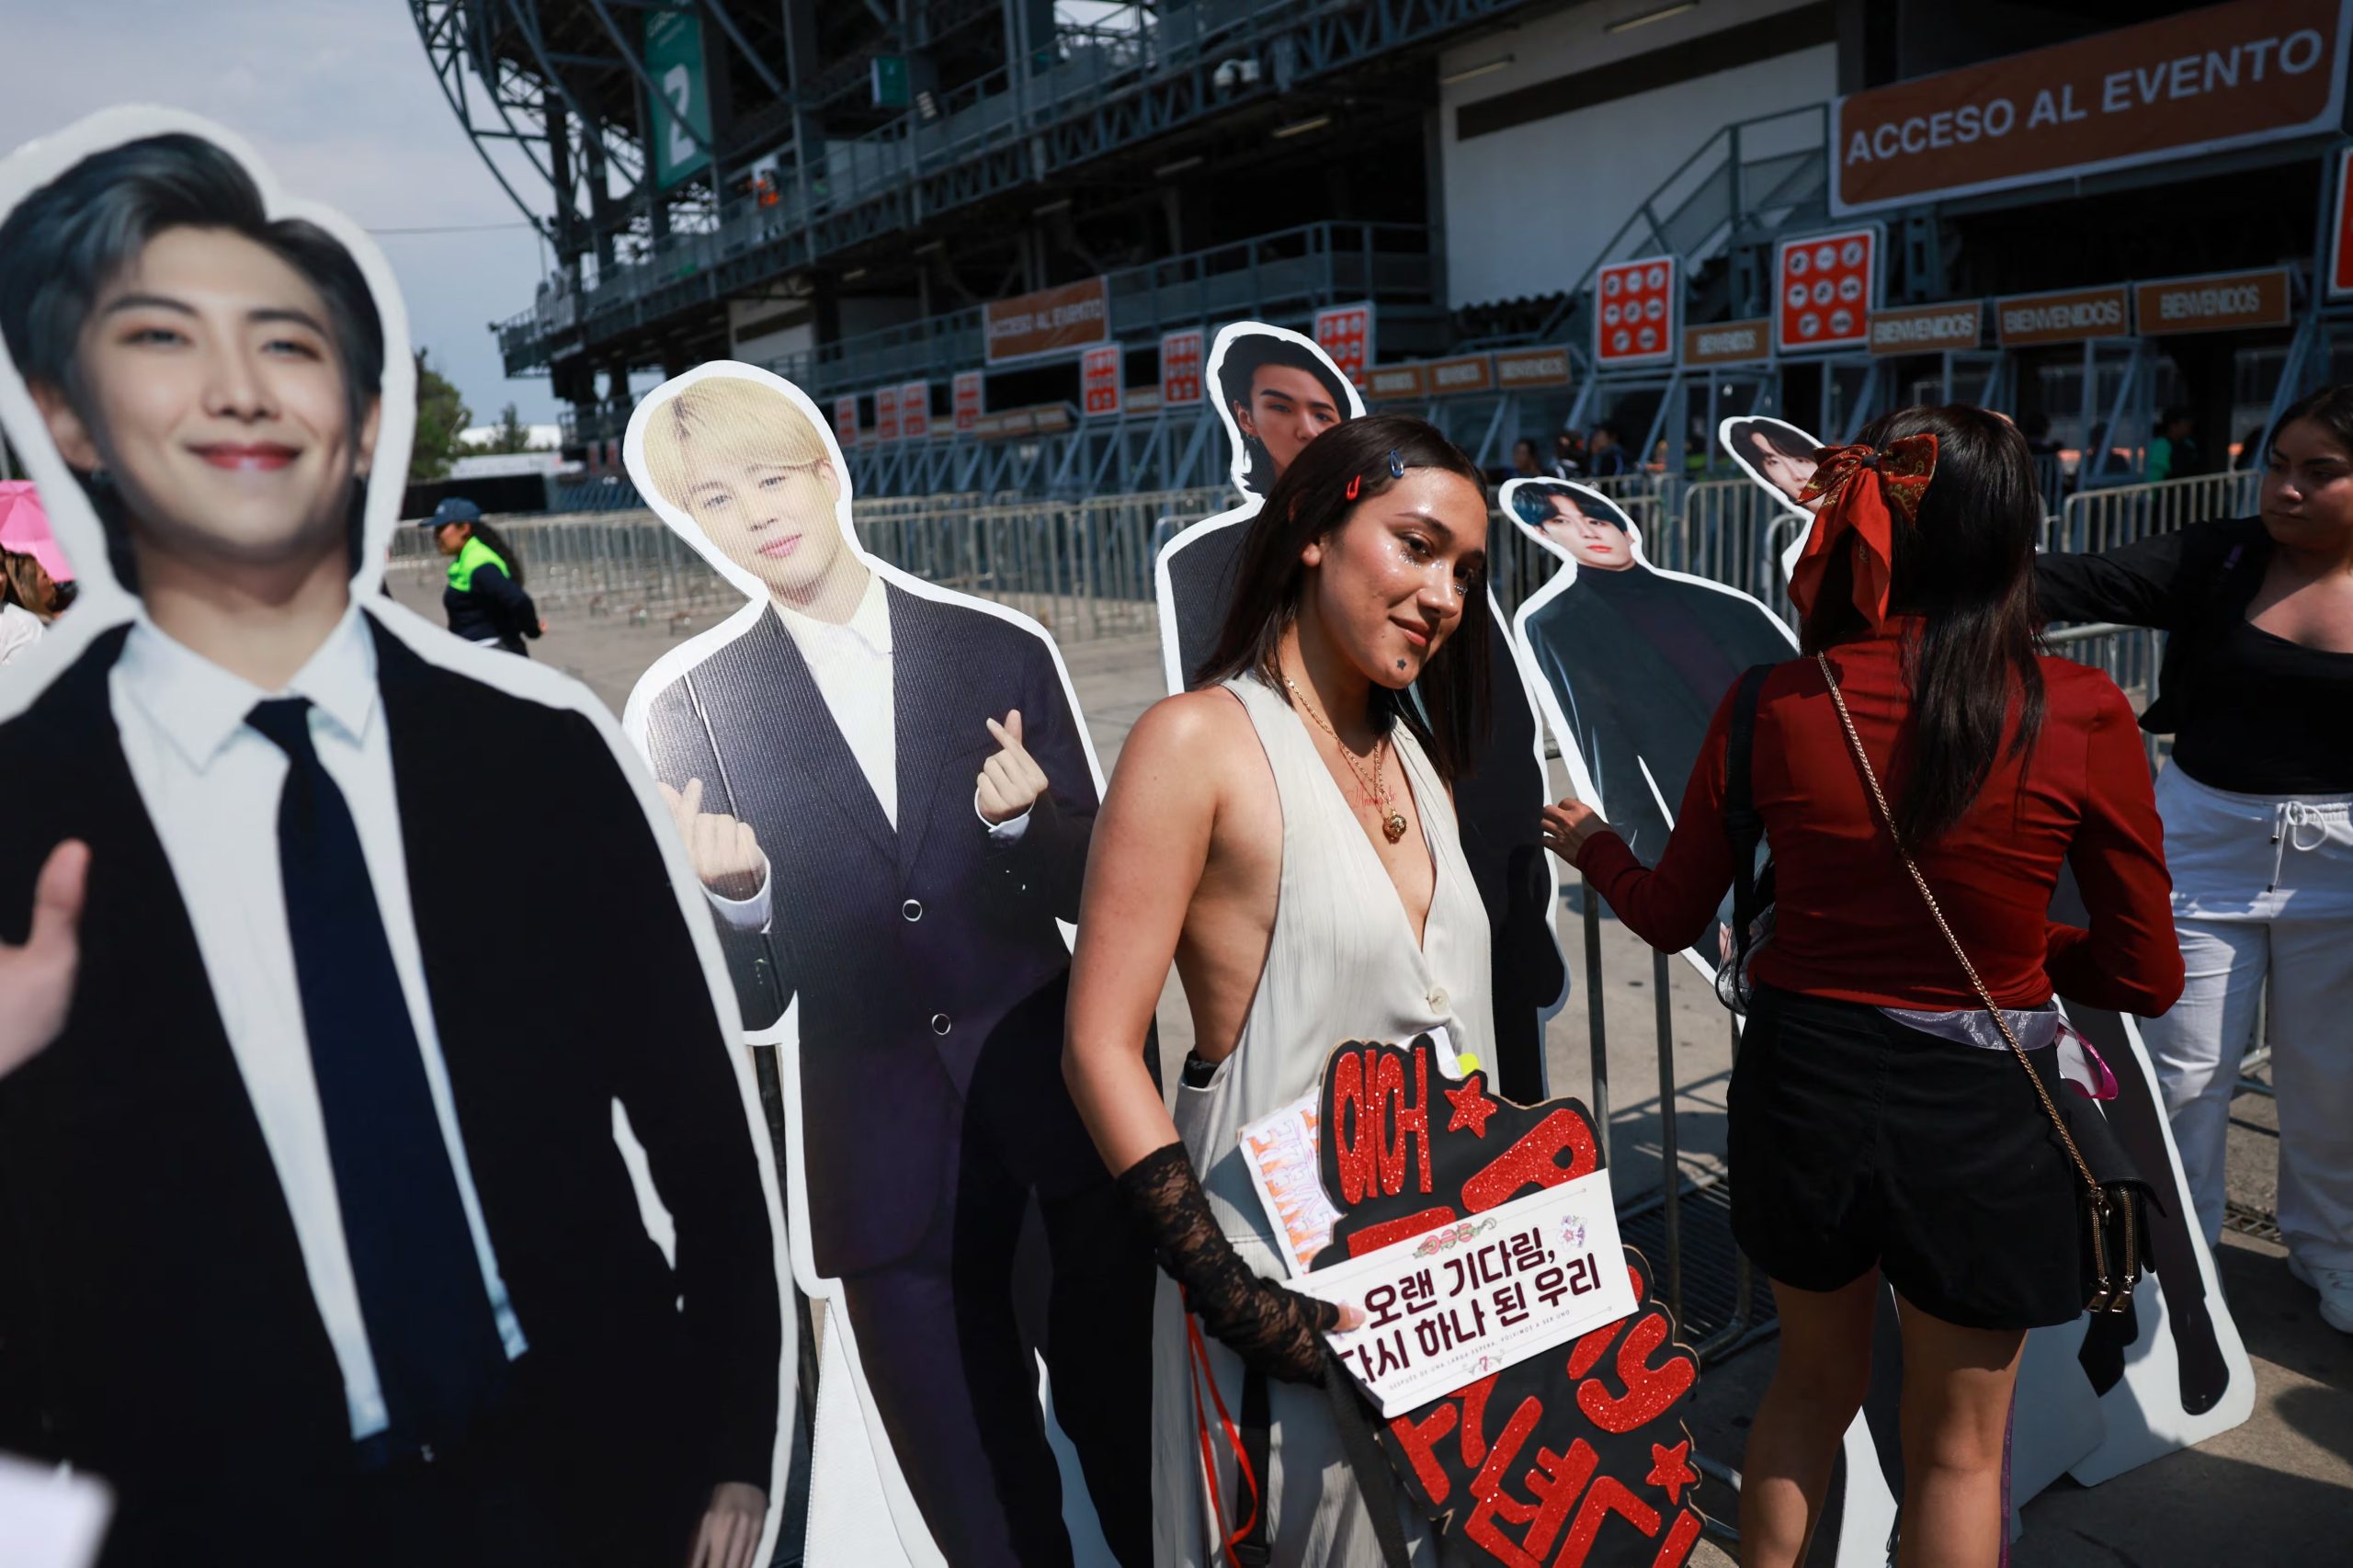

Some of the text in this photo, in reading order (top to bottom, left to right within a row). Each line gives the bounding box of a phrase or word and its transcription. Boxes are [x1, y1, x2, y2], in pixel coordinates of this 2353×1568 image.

[664, 63, 697, 166] 2
[1846, 28, 2323, 166] ACCESO AL EVENTO
[2003, 299, 2121, 335] BIENVENIDOS
[1364, 1267, 1438, 1329] 오랜
[1443, 1227, 1555, 1298] 기다림,
[1415, 1299, 1486, 1357] 하나
[1493, 1281, 1529, 1327] 된
[1535, 1252, 1602, 1307] 우리
